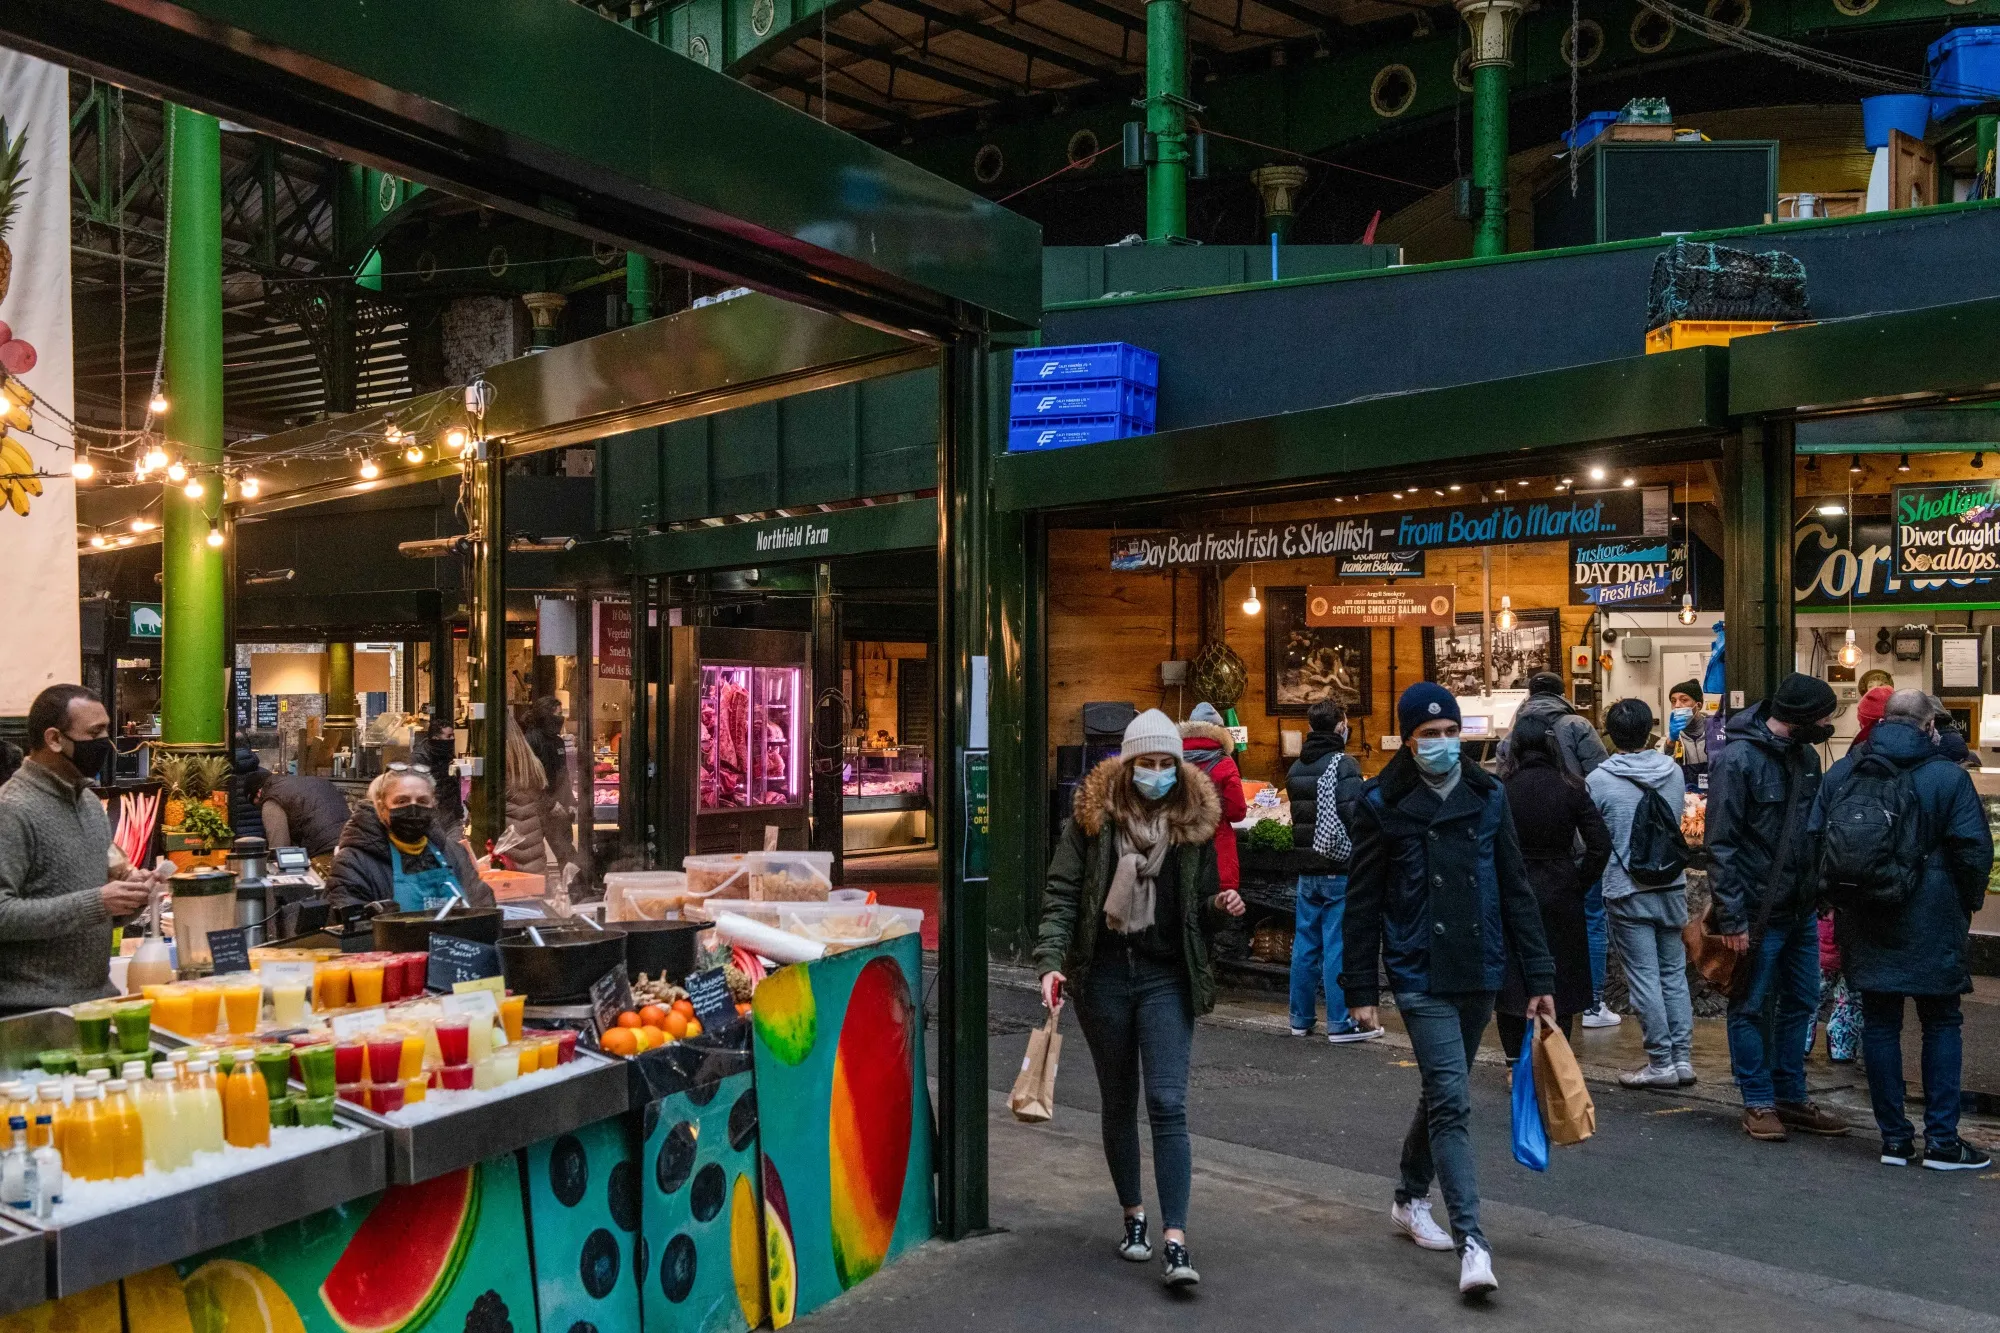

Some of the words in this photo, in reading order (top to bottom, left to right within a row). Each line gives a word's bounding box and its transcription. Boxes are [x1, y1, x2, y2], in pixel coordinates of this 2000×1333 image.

[756, 526, 803, 551] Northfield
[805, 524, 829, 546] Farm
[1140, 539, 1167, 568] Day
[1167, 536, 1202, 563] Boat
[1204, 532, 1244, 561] Fresh
[1245, 528, 1278, 559] Fish
[1282, 523, 1297, 558] &
[1298, 518, 1374, 555] Shellfish
[1398, 515, 1443, 546] From
[1448, 510, 1501, 543] Boat
[1502, 506, 1523, 540] To
[1900, 525, 1946, 547] Diver
[1947, 521, 2000, 551] Caught
[1576, 543, 1626, 563] Inshore
[1341, 560, 1372, 573] Iranian
[1574, 563, 1617, 584] DAY
[1617, 563, 1669, 584] BOAT
[1599, 584, 1631, 603] Fresh
[1332, 605, 1366, 615] SCOTTISH
[1367, 605, 1396, 615] SMOKED
[1398, 605, 1427, 615] SALMON
[1362, 615, 1378, 623] SOLD
[1379, 615, 1395, 623] HERE
[607, 627, 631, 641] Vegetabl
